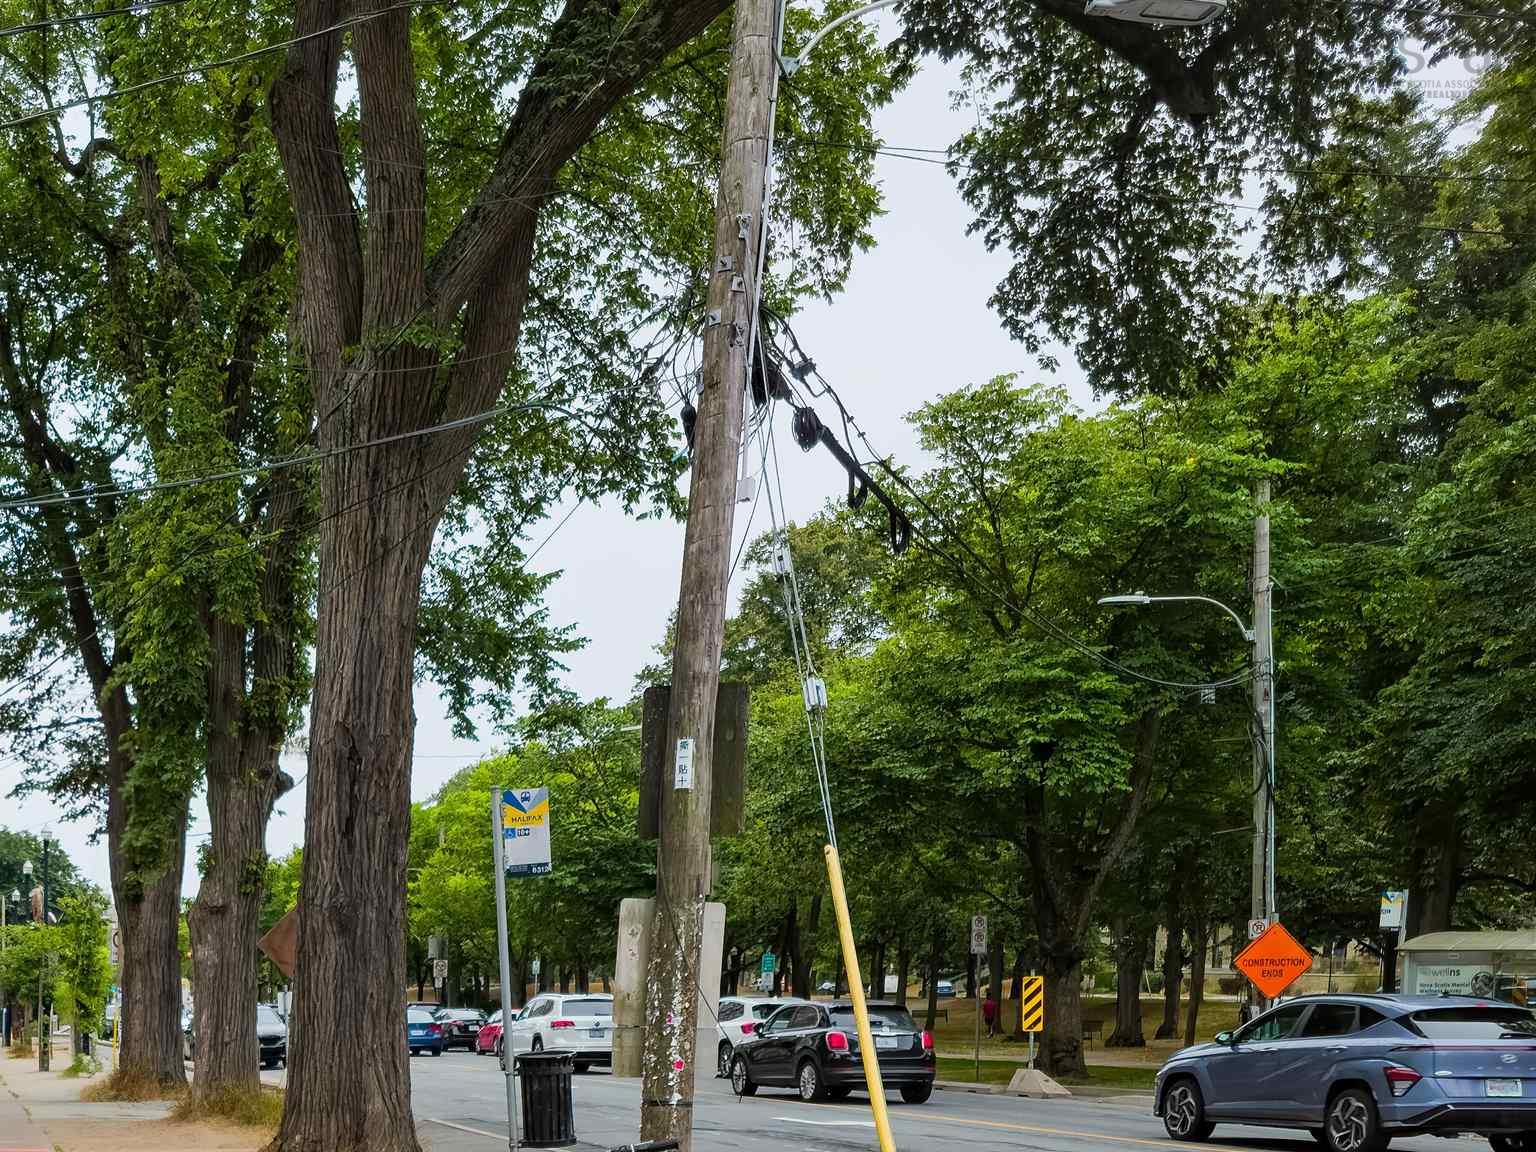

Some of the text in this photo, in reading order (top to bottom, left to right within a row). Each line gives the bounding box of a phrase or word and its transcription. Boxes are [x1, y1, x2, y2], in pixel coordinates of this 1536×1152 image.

[511, 815, 543, 823] HALIFAX
[1242, 958, 1305, 967] CONSTRUCTION
[1261, 969, 1284, 978] ENDS
